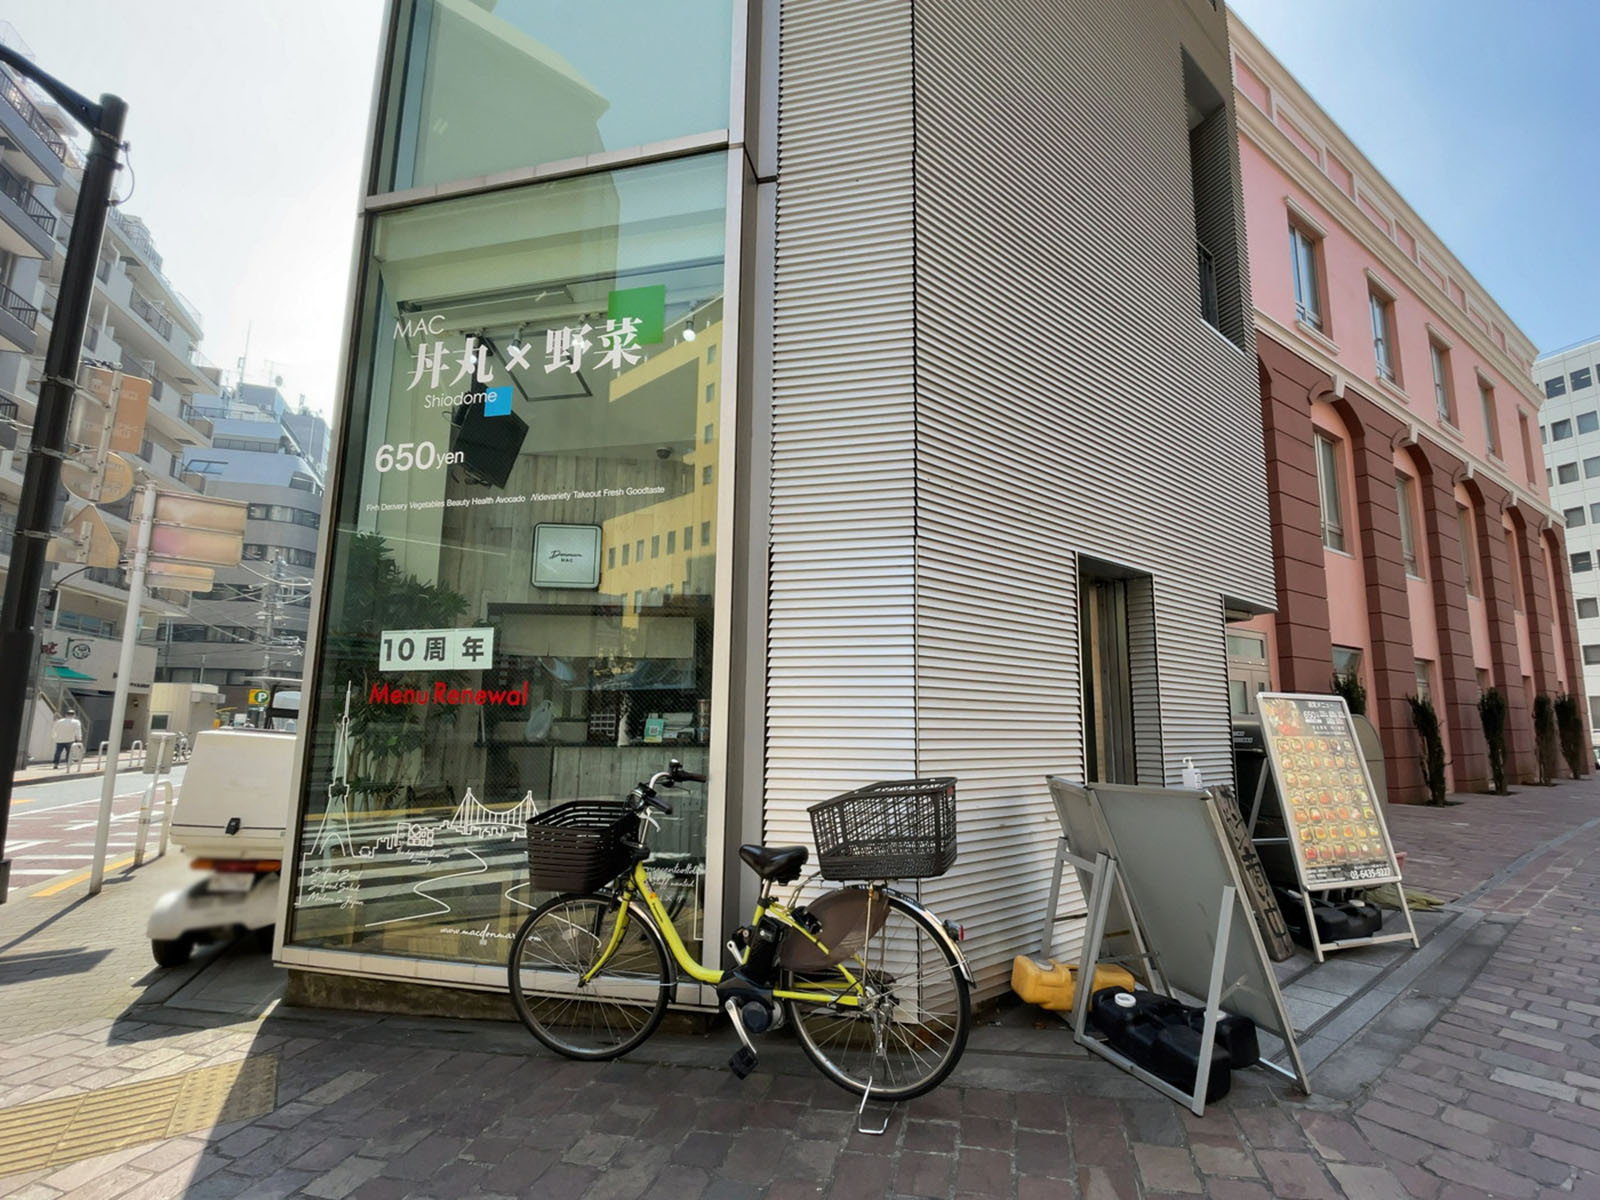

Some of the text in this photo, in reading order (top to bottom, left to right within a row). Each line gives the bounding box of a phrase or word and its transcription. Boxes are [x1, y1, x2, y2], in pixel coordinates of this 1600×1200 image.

[393, 315, 446, 340] MAC
[424, 391, 498, 409] Shiodome
[446, 497, 470, 508] Beauty
[471, 496, 494, 505] Health
[496, 494, 526, 504] Avocado
[573, 490, 601, 499] Takeout
[603, 488, 624, 497] Fresh
[626, 486, 665, 496] Goodtaste
[258, 692, 267, 702] P
[369, 680, 529, 706] Menu Renewal
